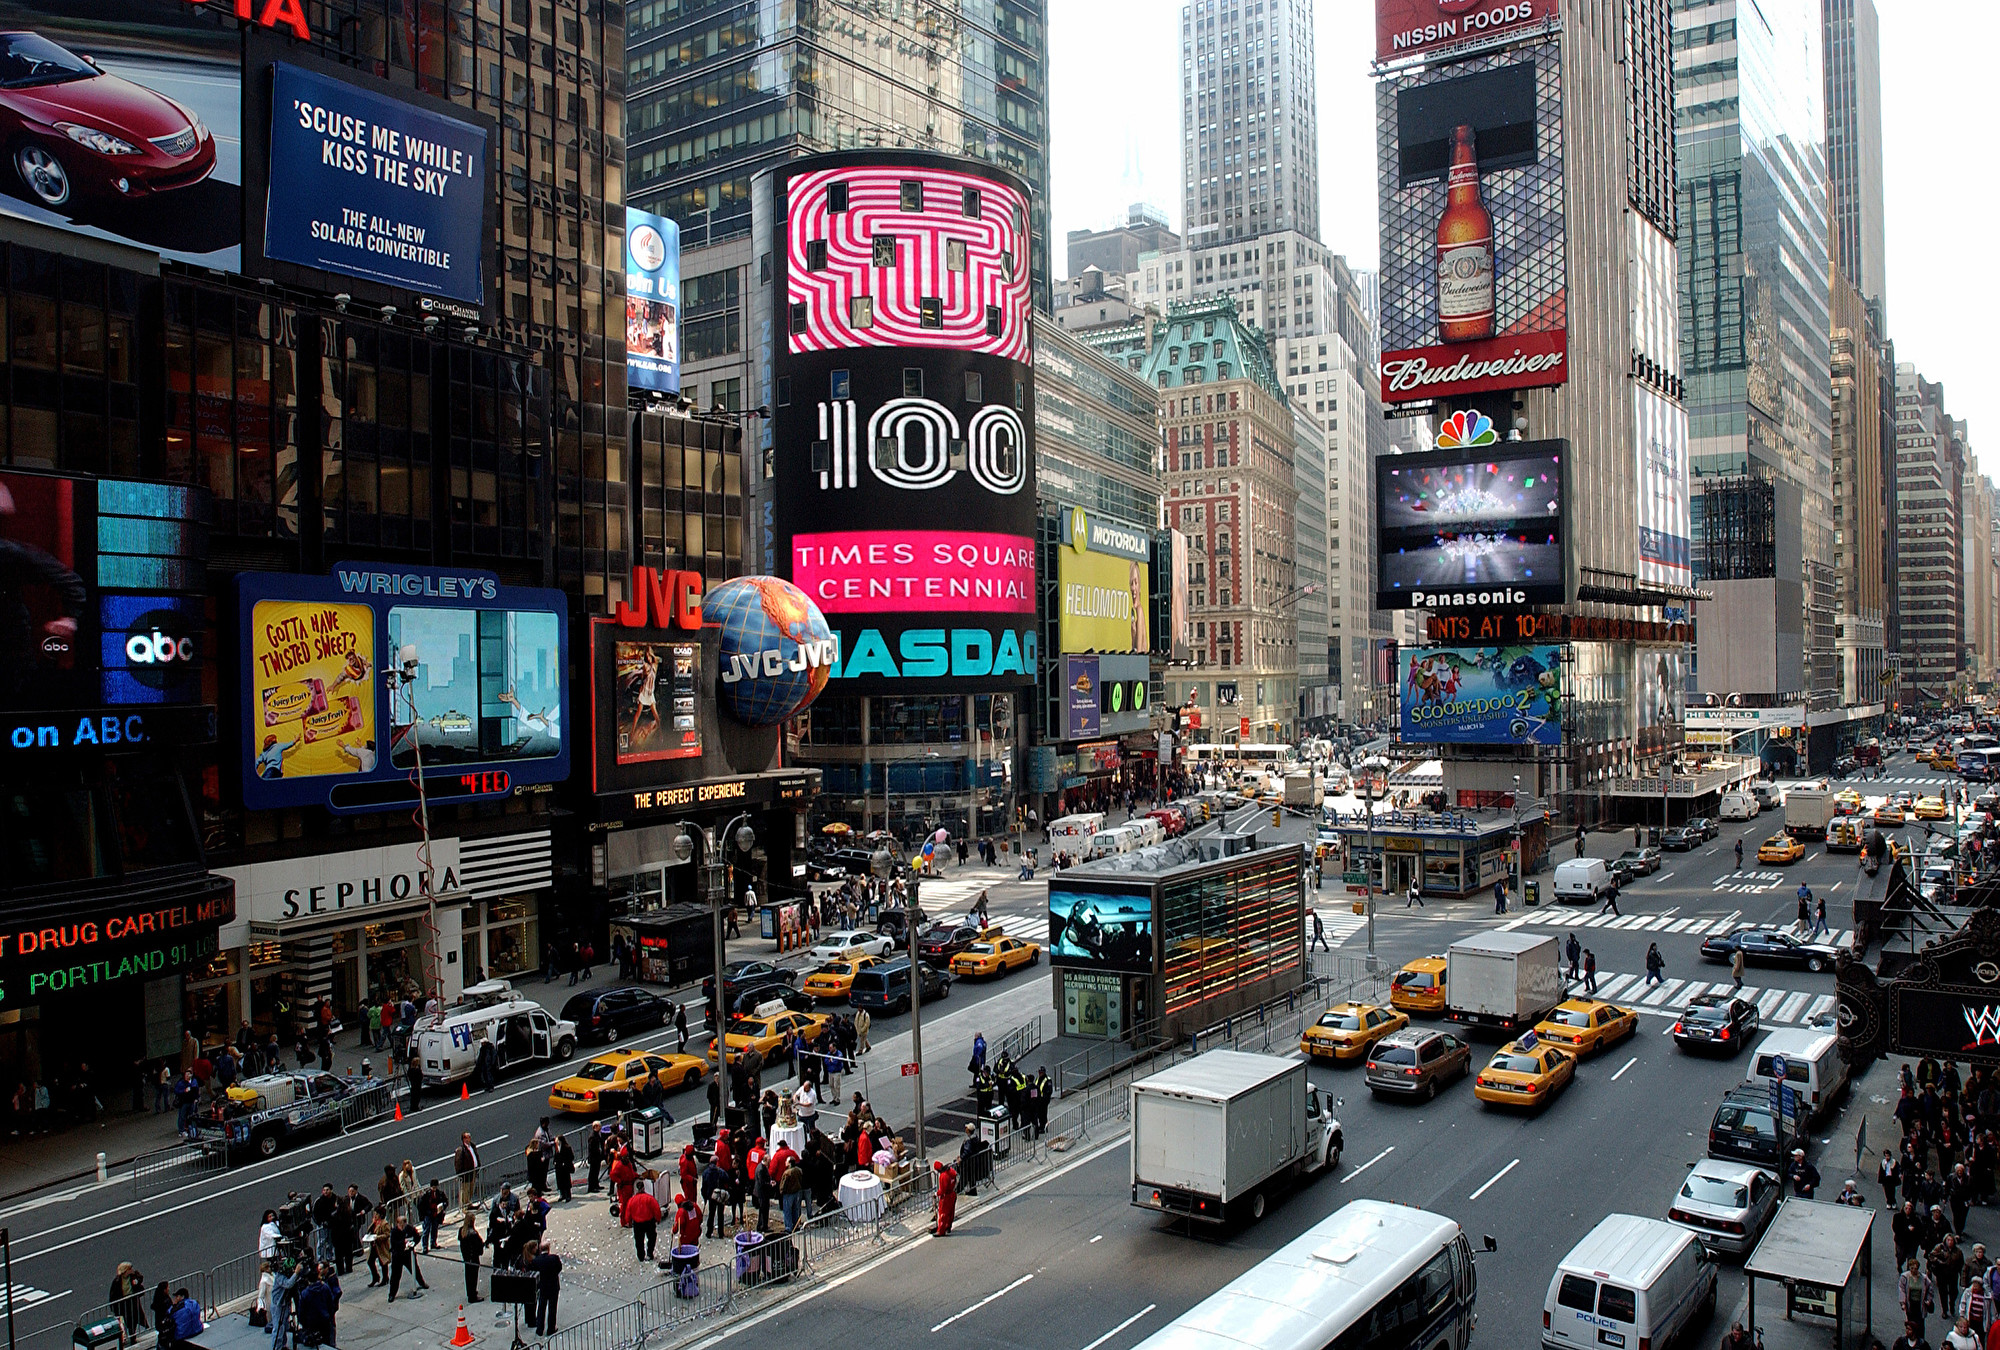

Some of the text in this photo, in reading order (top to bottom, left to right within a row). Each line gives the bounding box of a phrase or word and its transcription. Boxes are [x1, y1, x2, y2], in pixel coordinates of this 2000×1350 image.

[1393, 1, 1533, 50] NISSIN FOODS
[371, 124, 400, 157] ME
[404, 135, 463, 174] WHILE
[467, 154, 473, 178] I
[322, 139, 449, 197] KISS THE SKY
[342, 208, 426, 244] THE ALL-NEW
[311, 220, 451, 270] SOLARA CONVERTIBLE
[626, 271, 654, 294] oin
[1440, 280, 1491, 296] Budweiser
[1382, 350, 1564, 392] Budweiser
[1391, 408, 1430, 419] SHERWOOD
[817, 397, 1027, 495] 100
[764, 501, 774, 573] MAR
[1093, 525, 1147, 555] MOTOROLA
[796, 543, 1036, 568] TIMES SQUARE
[338, 571, 497, 600] WRIGLEY'S
[616, 565, 703, 630] JVC
[818, 577, 1028, 600] CENTENNIAL
[1411, 588, 1526, 607] Panasonic
[1066, 583, 1130, 621] HELLOMOTO
[266, 609, 339, 648] GOTTA HAVE
[1480, 616, 1504, 638] AT
[44, 643, 69, 652] abc
[126, 627, 193, 663] abc
[260, 632, 356, 678] TWISTED SWEET?
[788, 634, 838, 673] JVC
[722, 648, 783, 683] JVC
[272, 692, 307, 707] Juicy Fruit
[1411, 689, 1531, 723] SCOOBY-DOO 2
[11, 715, 151, 748] on ABC.
[311, 713, 328, 725] Juicy
[1420, 714, 1461, 729] MONSTERS
[634, 782, 746, 810] THE PERFECT EXPERIENCE
[1052, 825, 1079, 837] FedEx
[1083, 821, 1097, 838] FedEx
[1712, 883, 1769, 894] FIRE
[1732, 870, 1784, 881] LANE
[283, 866, 458, 918] SEPHORA
[18, 922, 98, 955] DRUG
[106, 906, 193, 940] CARTEL
[30, 950, 165, 995] PORTLAND
[1064, 973, 1120, 984] US ARMED FORCES
[1064, 981, 1120, 993] RECRUITING STATION
[453, 1026, 467, 1034] NY
[1576, 1312, 1617, 1329] POLICE
